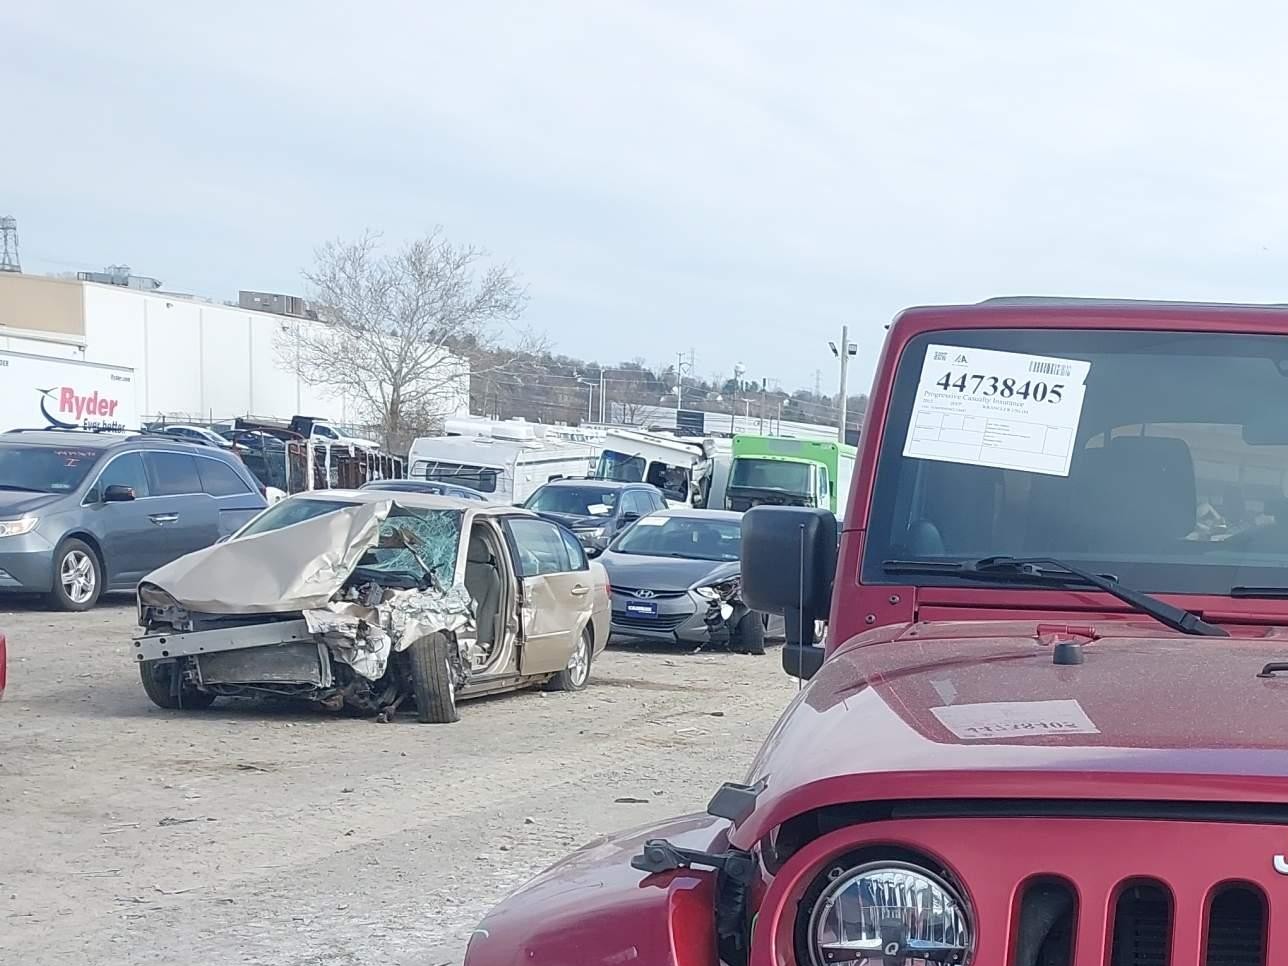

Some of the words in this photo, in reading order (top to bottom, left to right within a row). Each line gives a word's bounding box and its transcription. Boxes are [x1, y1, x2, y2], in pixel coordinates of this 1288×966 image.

[60, 387, 118, 420] Ryder
[924, 390, 962, 400] Progressive
[962, 394, 991, 404] Casualty
[992, 397, 1025, 407] Insurance
[936, 371, 1065, 404] 44738405
